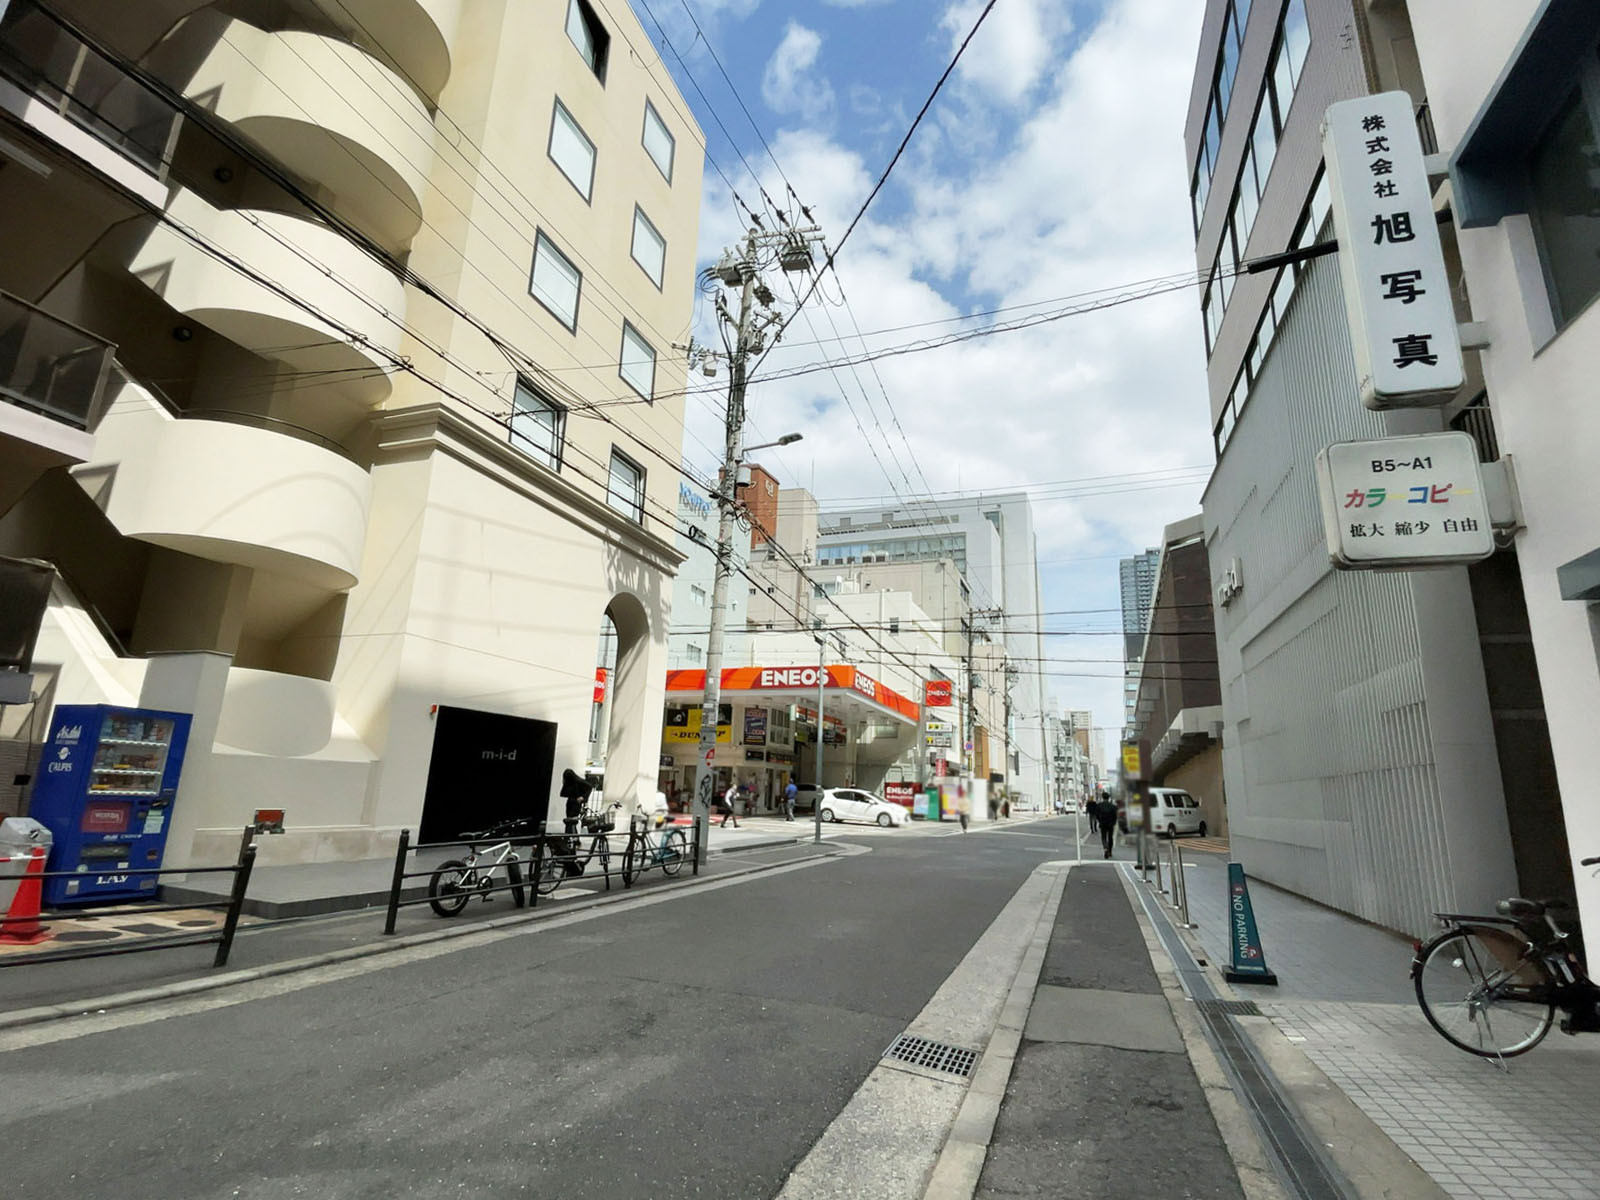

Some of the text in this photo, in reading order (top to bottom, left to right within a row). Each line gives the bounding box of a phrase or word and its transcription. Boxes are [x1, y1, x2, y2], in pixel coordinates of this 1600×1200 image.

[1361, 113, 1438, 368] 株式会社 旭写真
[1344, 483, 1473, 508] カラーコピー
[1350, 518, 1478, 538] 拡大 縮少 自由
[761, 668, 829, 686] ENEOS
[854, 673, 875, 697] ENEOS
[482, 748, 517, 760] m-i-d
[1233, 894, 1249, 959] NO PARKING
